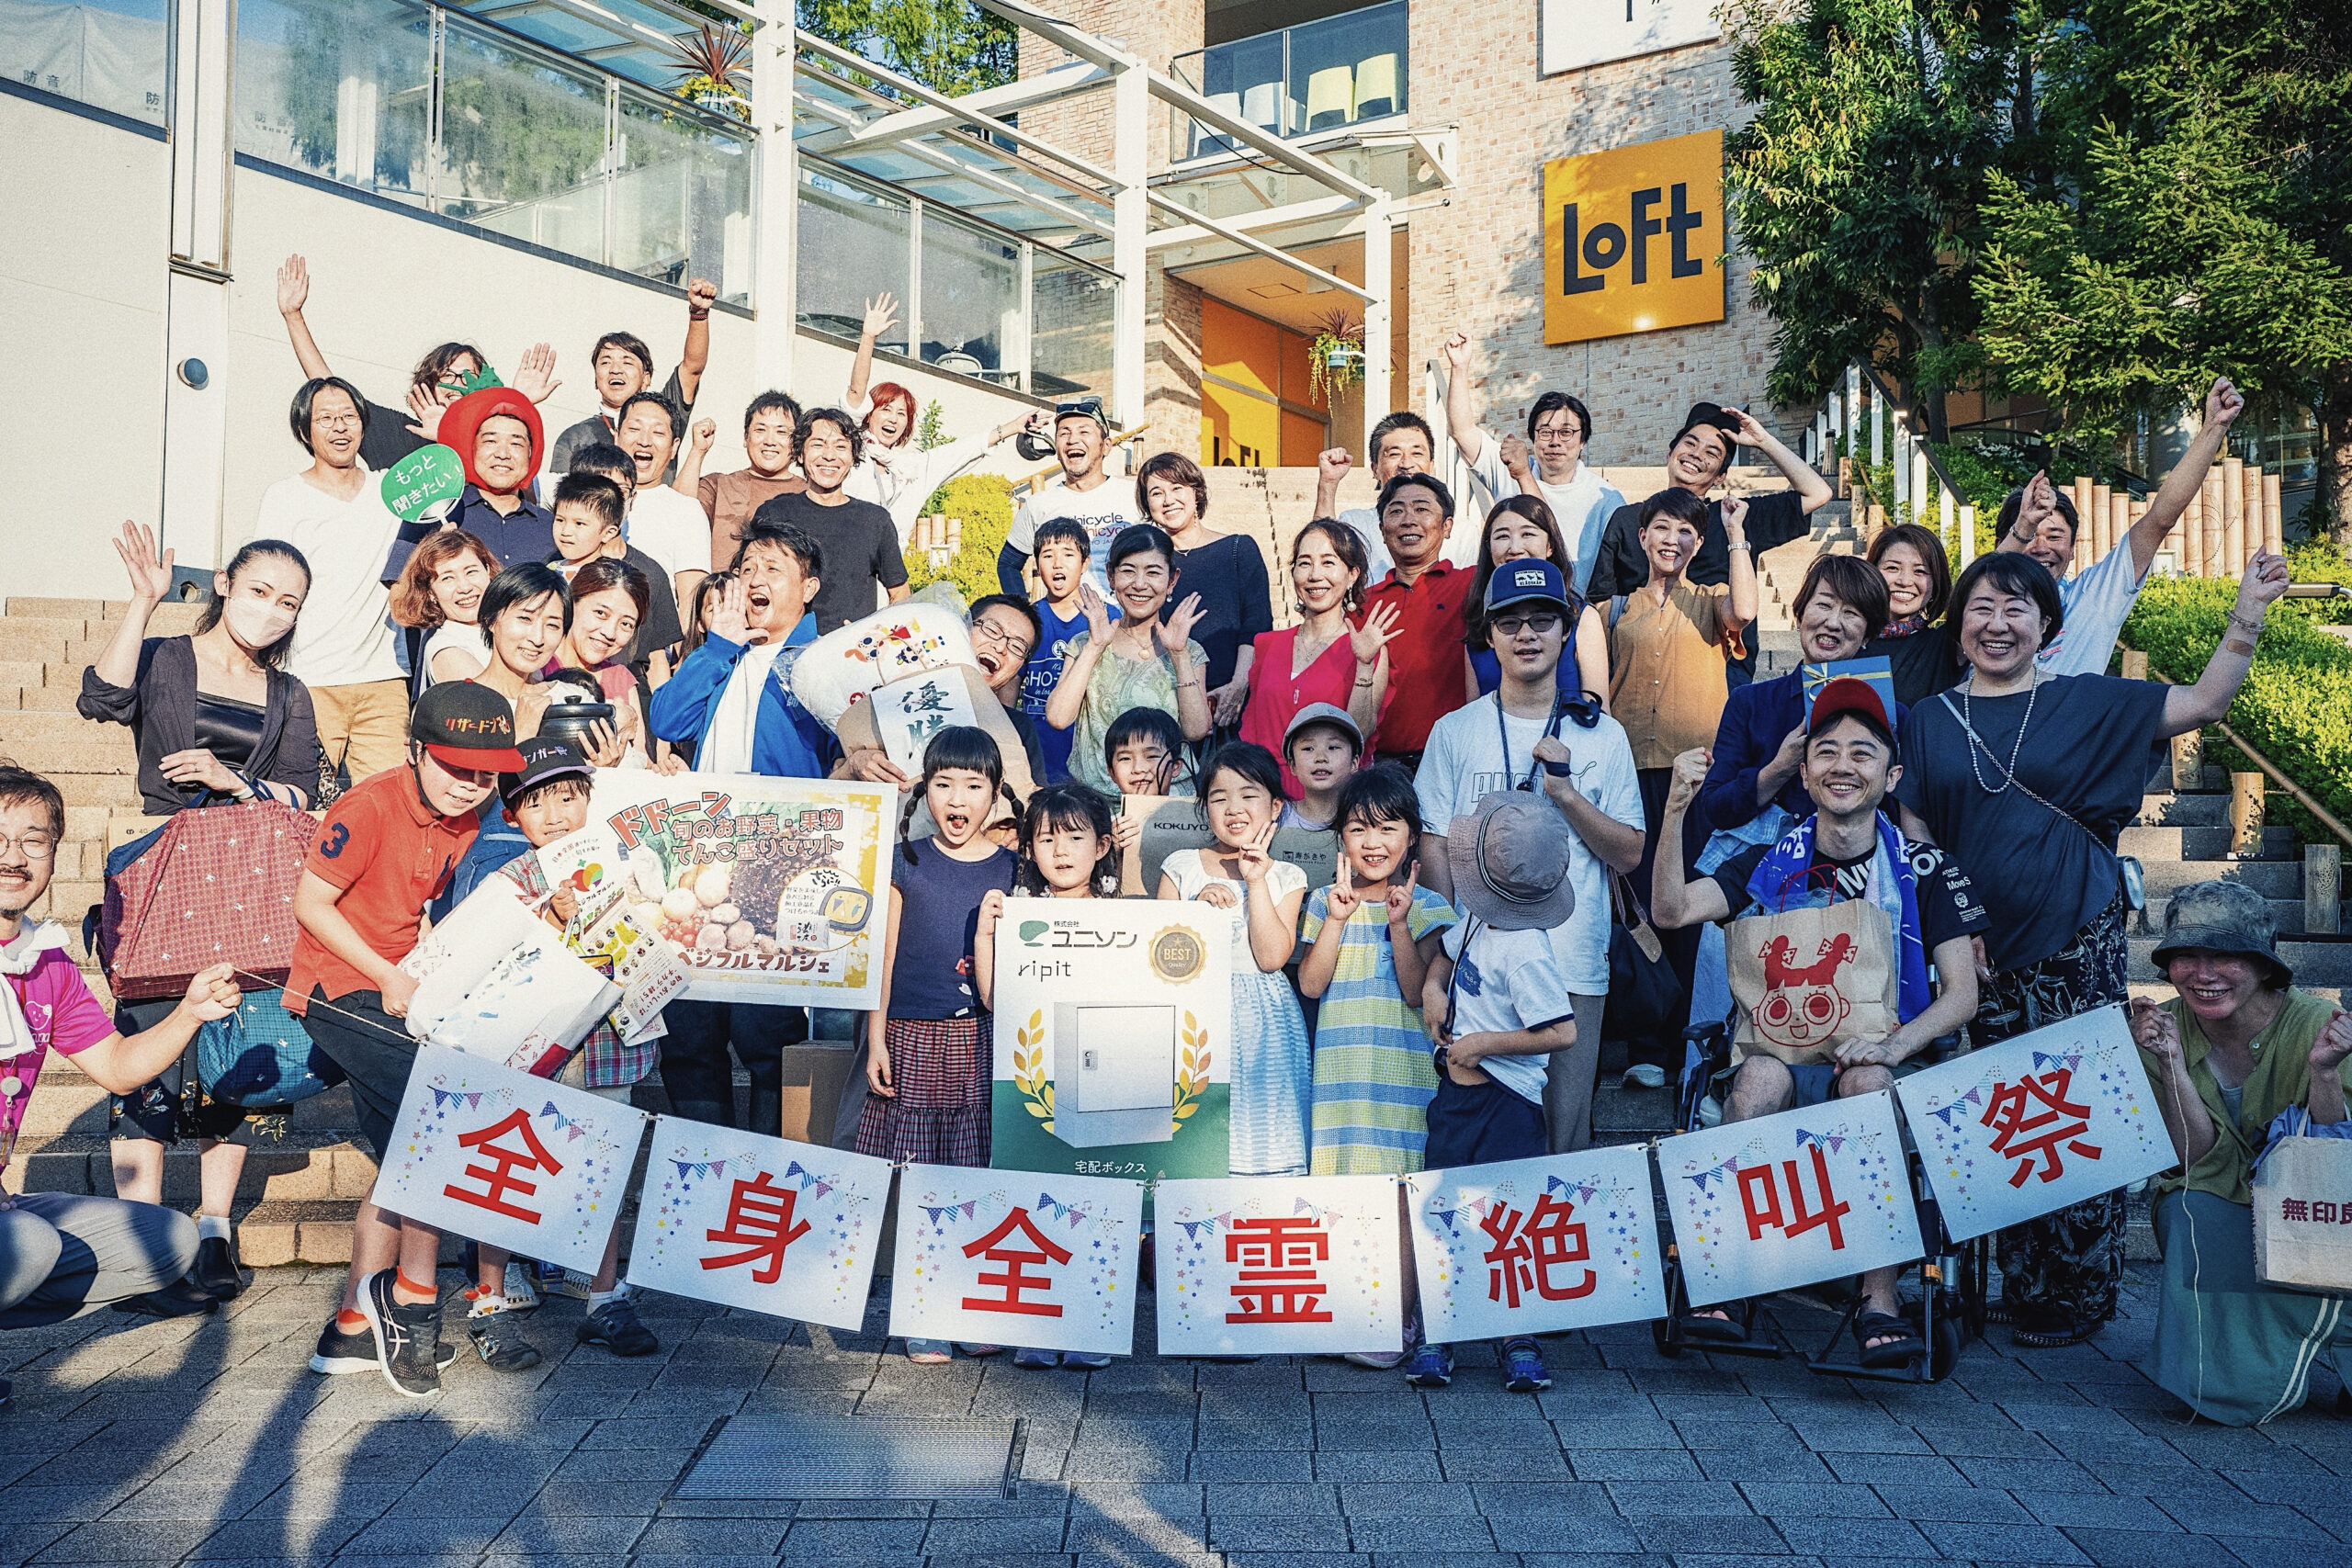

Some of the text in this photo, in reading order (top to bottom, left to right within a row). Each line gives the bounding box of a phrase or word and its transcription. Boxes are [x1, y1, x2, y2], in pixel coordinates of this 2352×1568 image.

[395, 455, 436, 484] もっと
[1073, 513, 1124, 525] hicycle
[607, 791, 731, 851] ドドーン
[671, 808, 843, 841] 旬のお野菜・果物
[1153, 822, 1209, 831] KOKUYO
[321, 822, 350, 859] 3
[672, 834, 843, 865] てんこ盛りセット
[1051, 931, 1137, 948] ユニソン
[1163, 948, 1192, 960] BEST
[1018, 960, 1071, 982] ripit
[1075, 1160, 1147, 1174] 宅配ボックス
